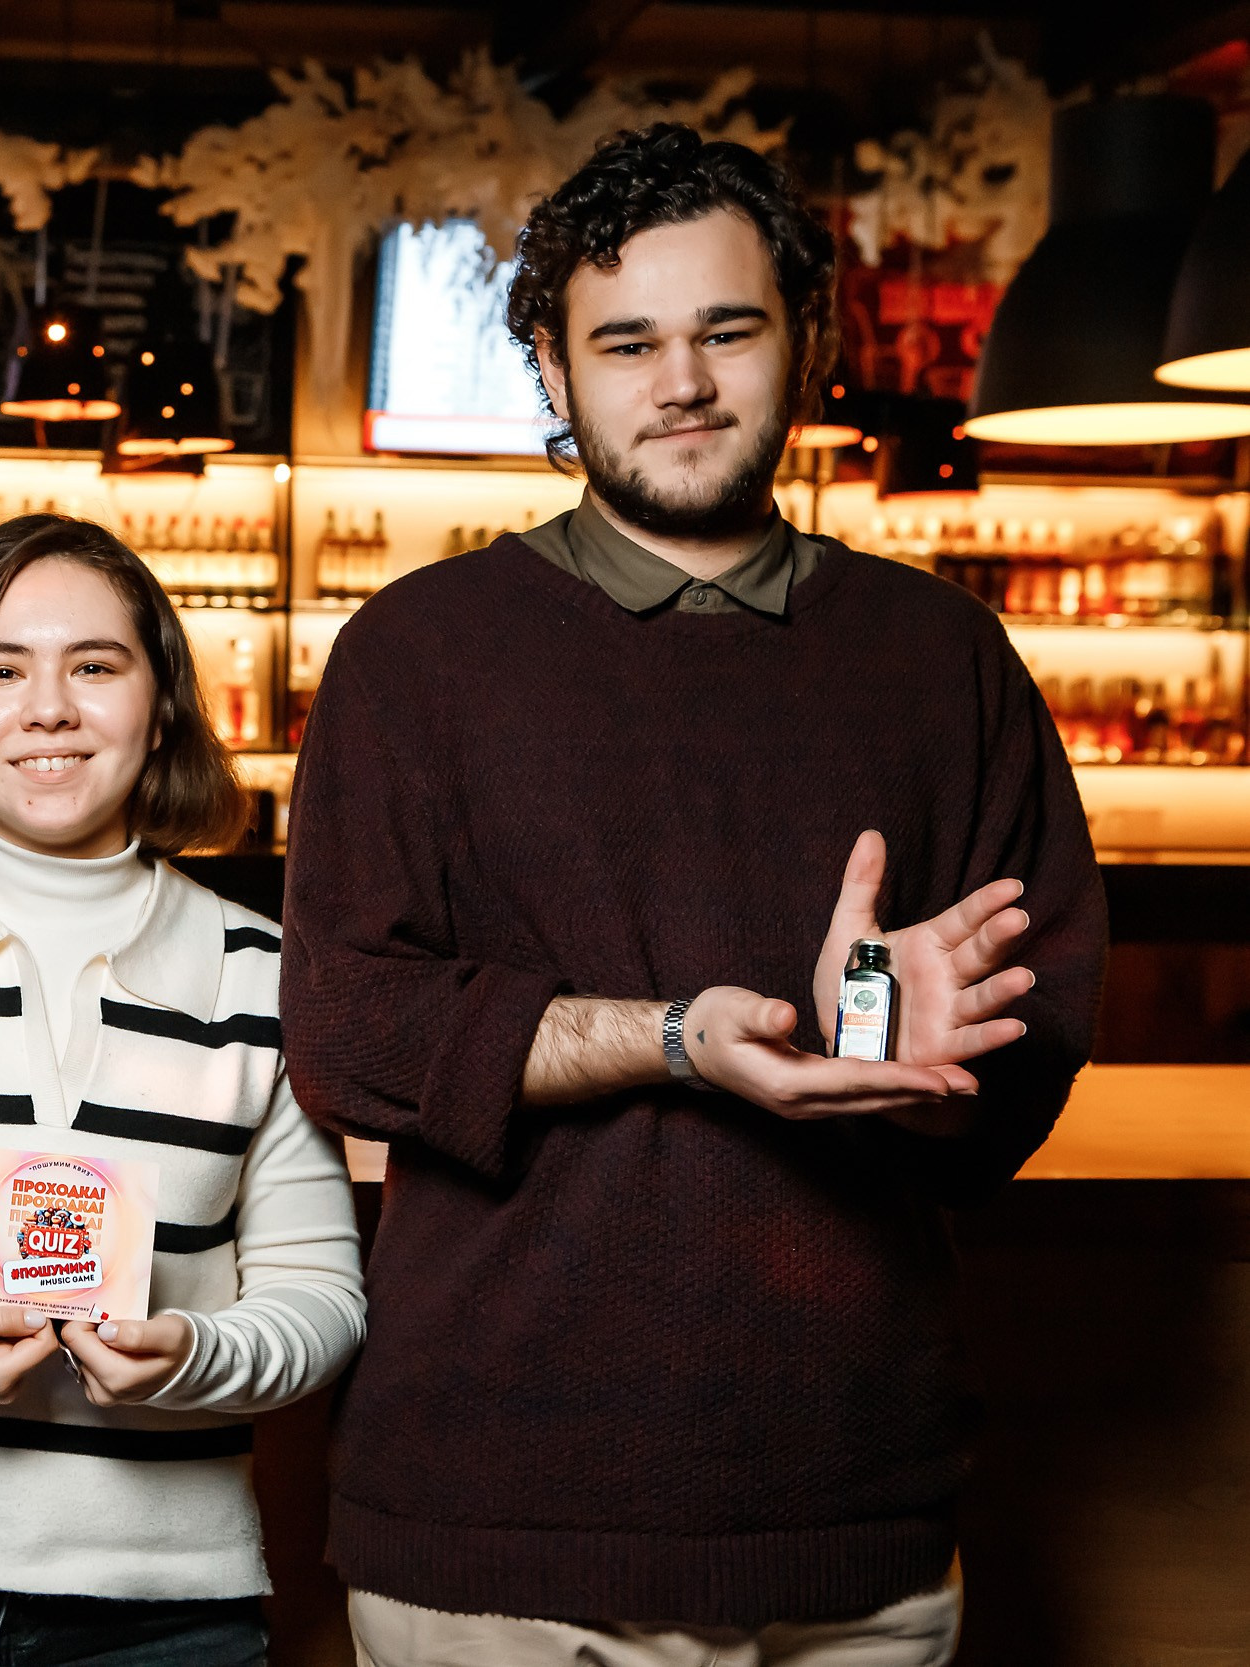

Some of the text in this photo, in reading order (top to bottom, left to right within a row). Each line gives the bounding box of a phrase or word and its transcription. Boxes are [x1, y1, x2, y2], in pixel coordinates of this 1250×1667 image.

[12, 1178, 106, 1200] ПРОХОДКА!
[11, 1193, 105, 1214] ПРОХОДКА!
[28, 1230, 80, 1254] QUIZ
[11, 1260, 97, 1280] #ПОШУМИМ?
[40, 1274, 95, 1287] #MUSIC GAME
